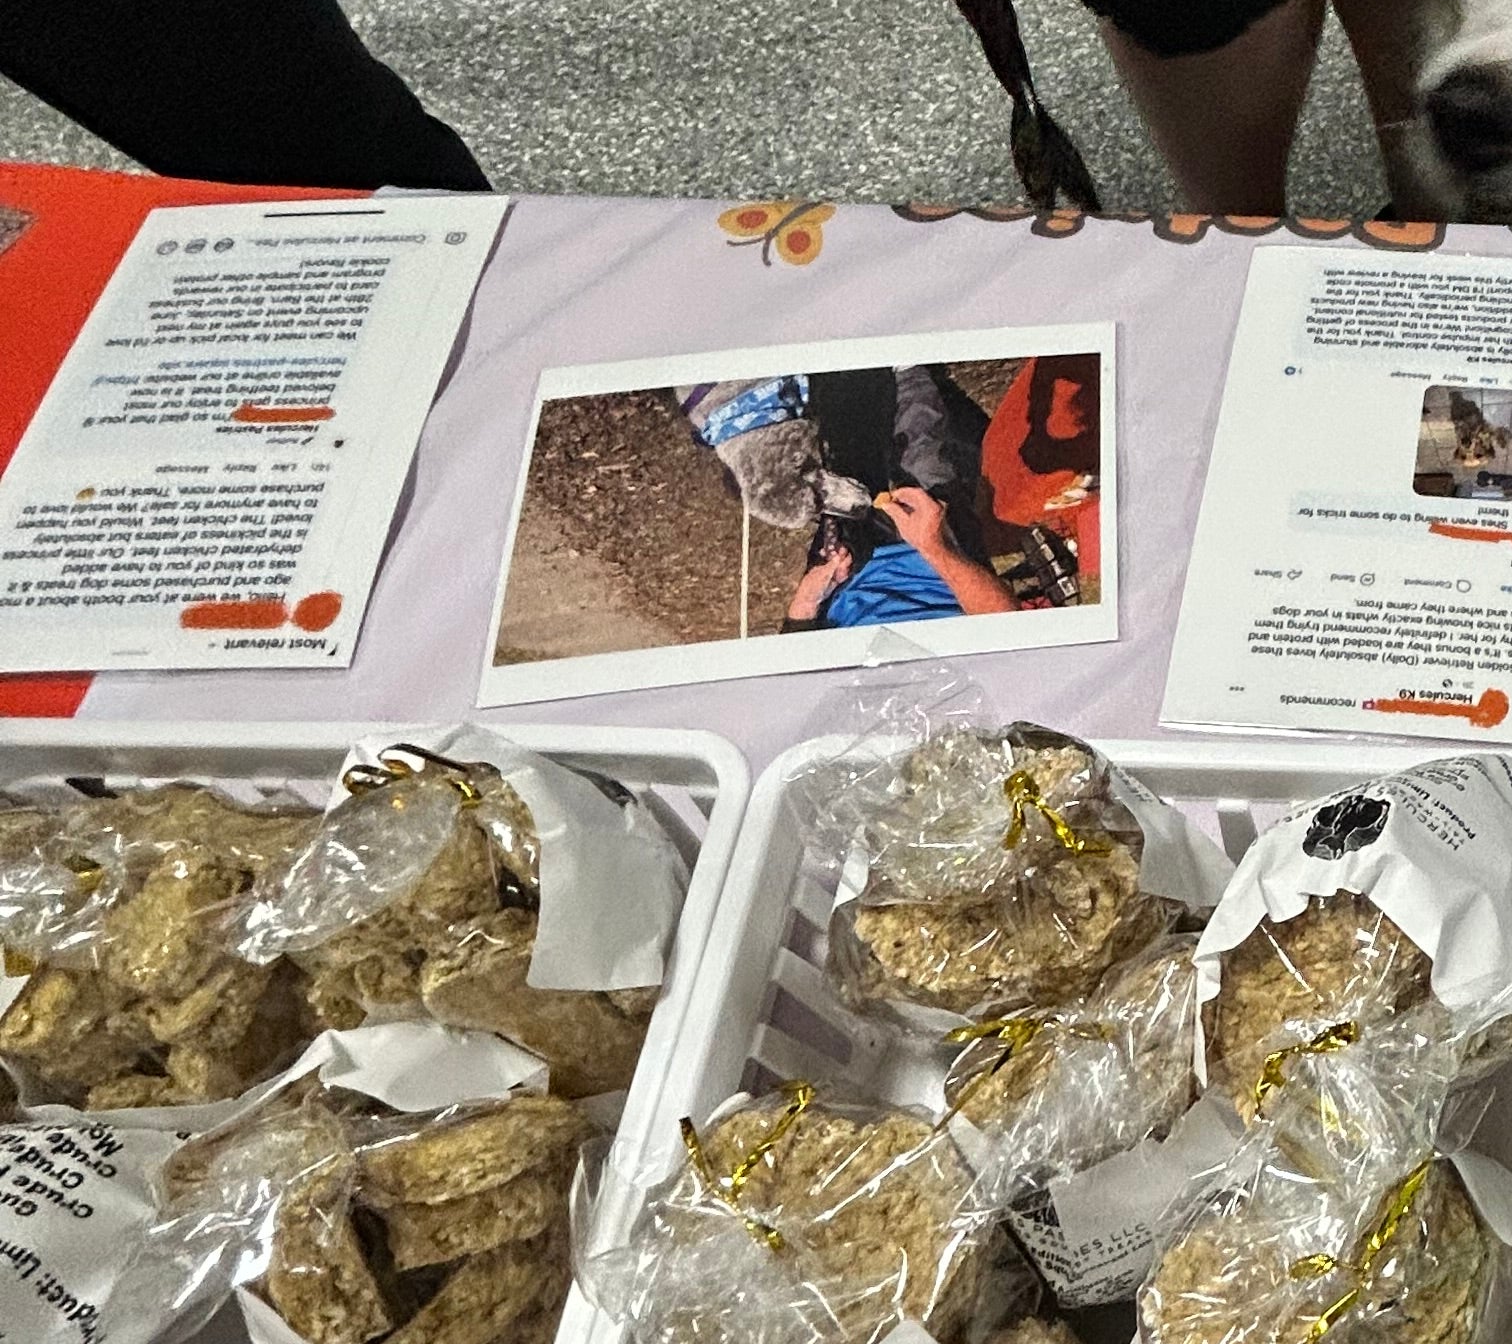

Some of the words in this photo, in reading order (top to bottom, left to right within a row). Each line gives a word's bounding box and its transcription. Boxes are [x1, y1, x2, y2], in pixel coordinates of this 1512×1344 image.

[1355, 600, 1383, 611] from.
[1386, 602, 1418, 611] came
[1420, 603, 1446, 615] they
[1273, 606, 1301, 618] dogs
[1304, 608, 1329, 618] your
[1332, 611, 1343, 621] in
[1448, 606, 1484, 617] where
[1486, 609, 1508, 618] and
[1346, 612, 1379, 623] whats
[1382, 613, 1423, 624] exactly
[1426, 616, 1474, 630] knowing
[1254, 620, 1284, 630] them
[1287, 620, 1320, 632] trying
[1323, 624, 1392, 635] recommend
[1477, 621, 1501, 631] nice
[1248, 632, 1271, 642] and
[1273, 634, 1314, 644] protein
[1395, 628, 1447, 641] definitely
[1450, 633, 1454, 642] I
[1459, 633, 1478, 644] her.
[224, 639, 286, 650] relevant
[289, 639, 327, 650] Most
[1316, 637, 1340, 647] with
[1343, 638, 1383, 650] loaded
[1385, 641, 1405, 650] are
[1481, 635, 1497, 646] for
[1251, 646, 1283, 657] these
[1407, 642, 1432, 653] they
[1436, 644, 1472, 656] bonus
[1474, 647, 1482, 656] a
[1286, 648, 1317, 659] loves
[1320, 649, 1379, 662] absolutely
[1484, 648, 1502, 659] It's
[1382, 653, 1419, 666] (Dolly)
[1423, 657, 1475, 671] Retriever
[1280, 695, 1356, 708] recommends
[1419, 691, 1473, 704] Hercules
